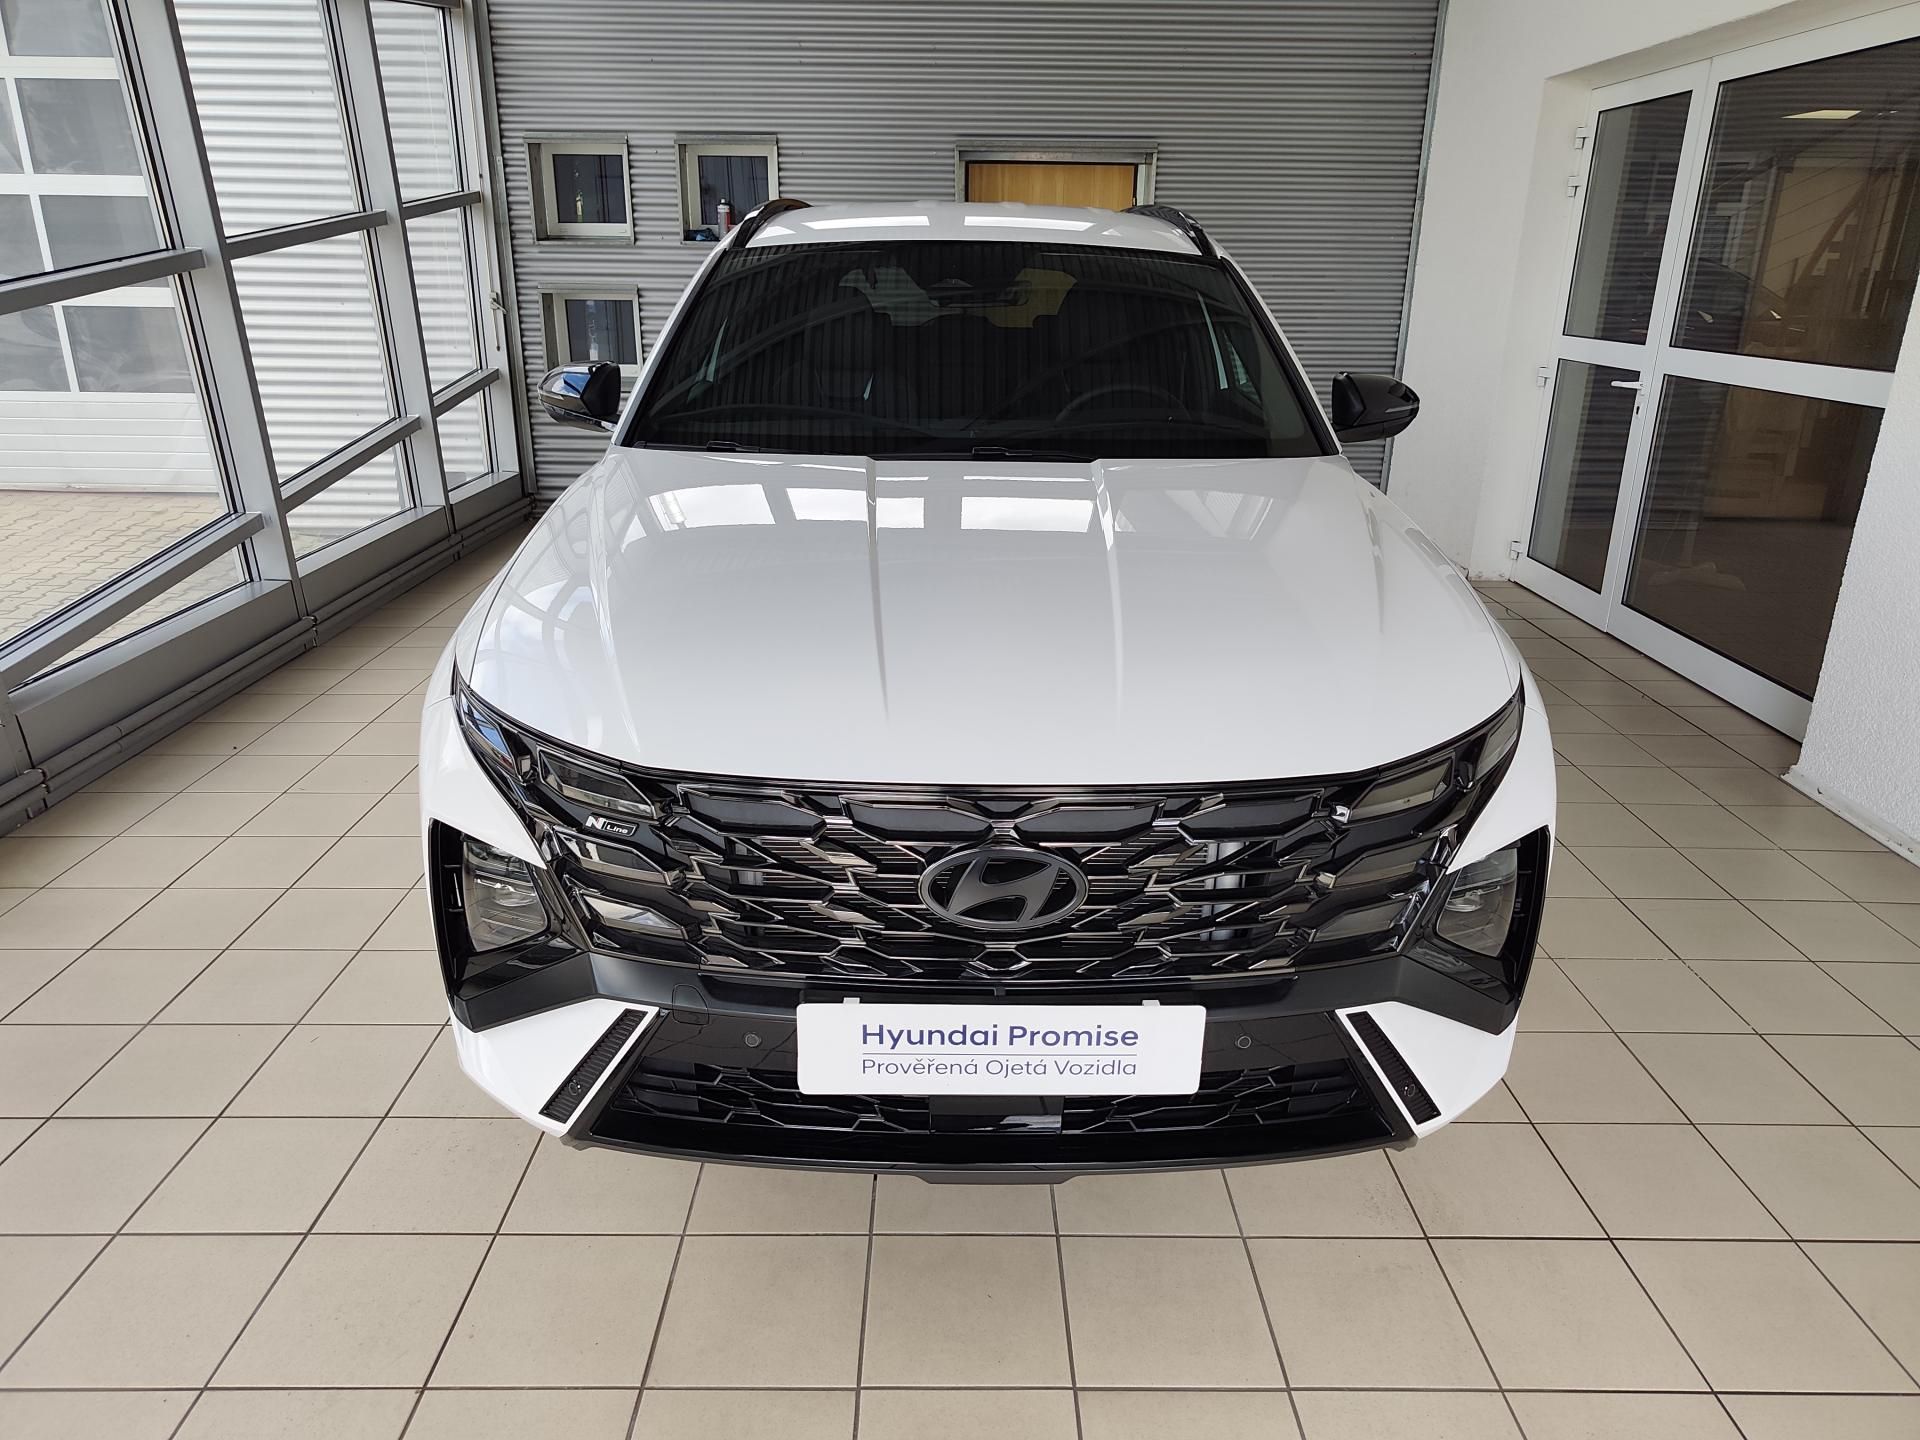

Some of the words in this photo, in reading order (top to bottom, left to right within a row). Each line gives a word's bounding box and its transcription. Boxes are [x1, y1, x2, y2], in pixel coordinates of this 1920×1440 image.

[585, 815, 606, 830] N
[606, 824, 629, 834] Line
[862, 1024, 998, 1050] Hyundai
[1008, 1024, 1139, 1047] Promise
[862, 1058, 978, 1075] Prověřená
[986, 1059, 1047, 1079] Ojetá
[1054, 1059, 1137, 1076] Vozidla
